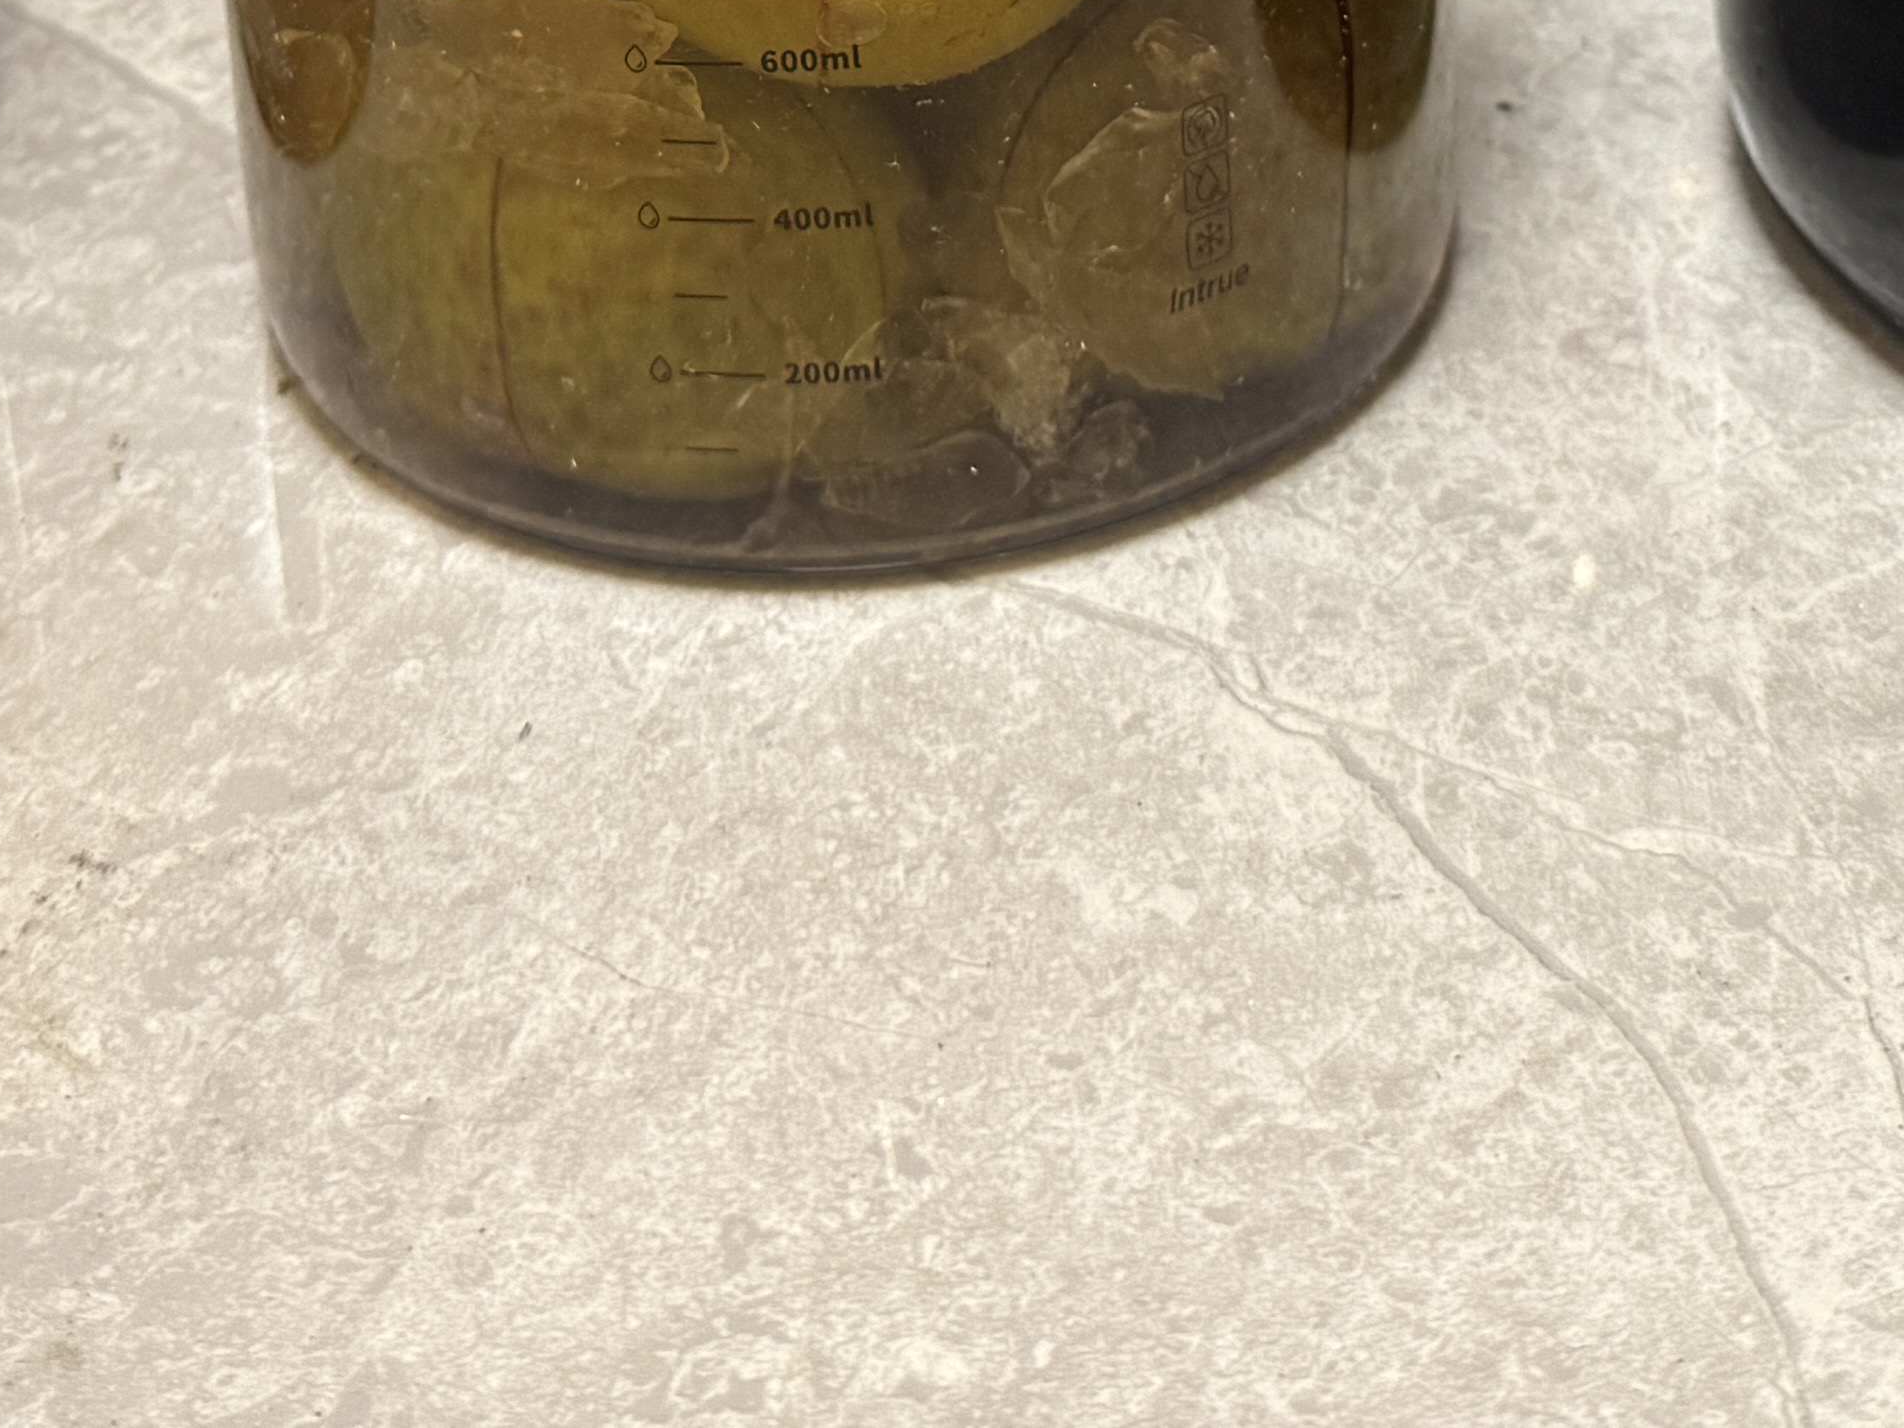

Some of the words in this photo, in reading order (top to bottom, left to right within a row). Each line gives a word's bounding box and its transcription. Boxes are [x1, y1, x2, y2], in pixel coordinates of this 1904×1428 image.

[760, 44, 863, 75] 600ml
[773, 203, 875, 233] 400ml
[1170, 261, 1250, 315] Intrue
[784, 356, 884, 386] 200ml
